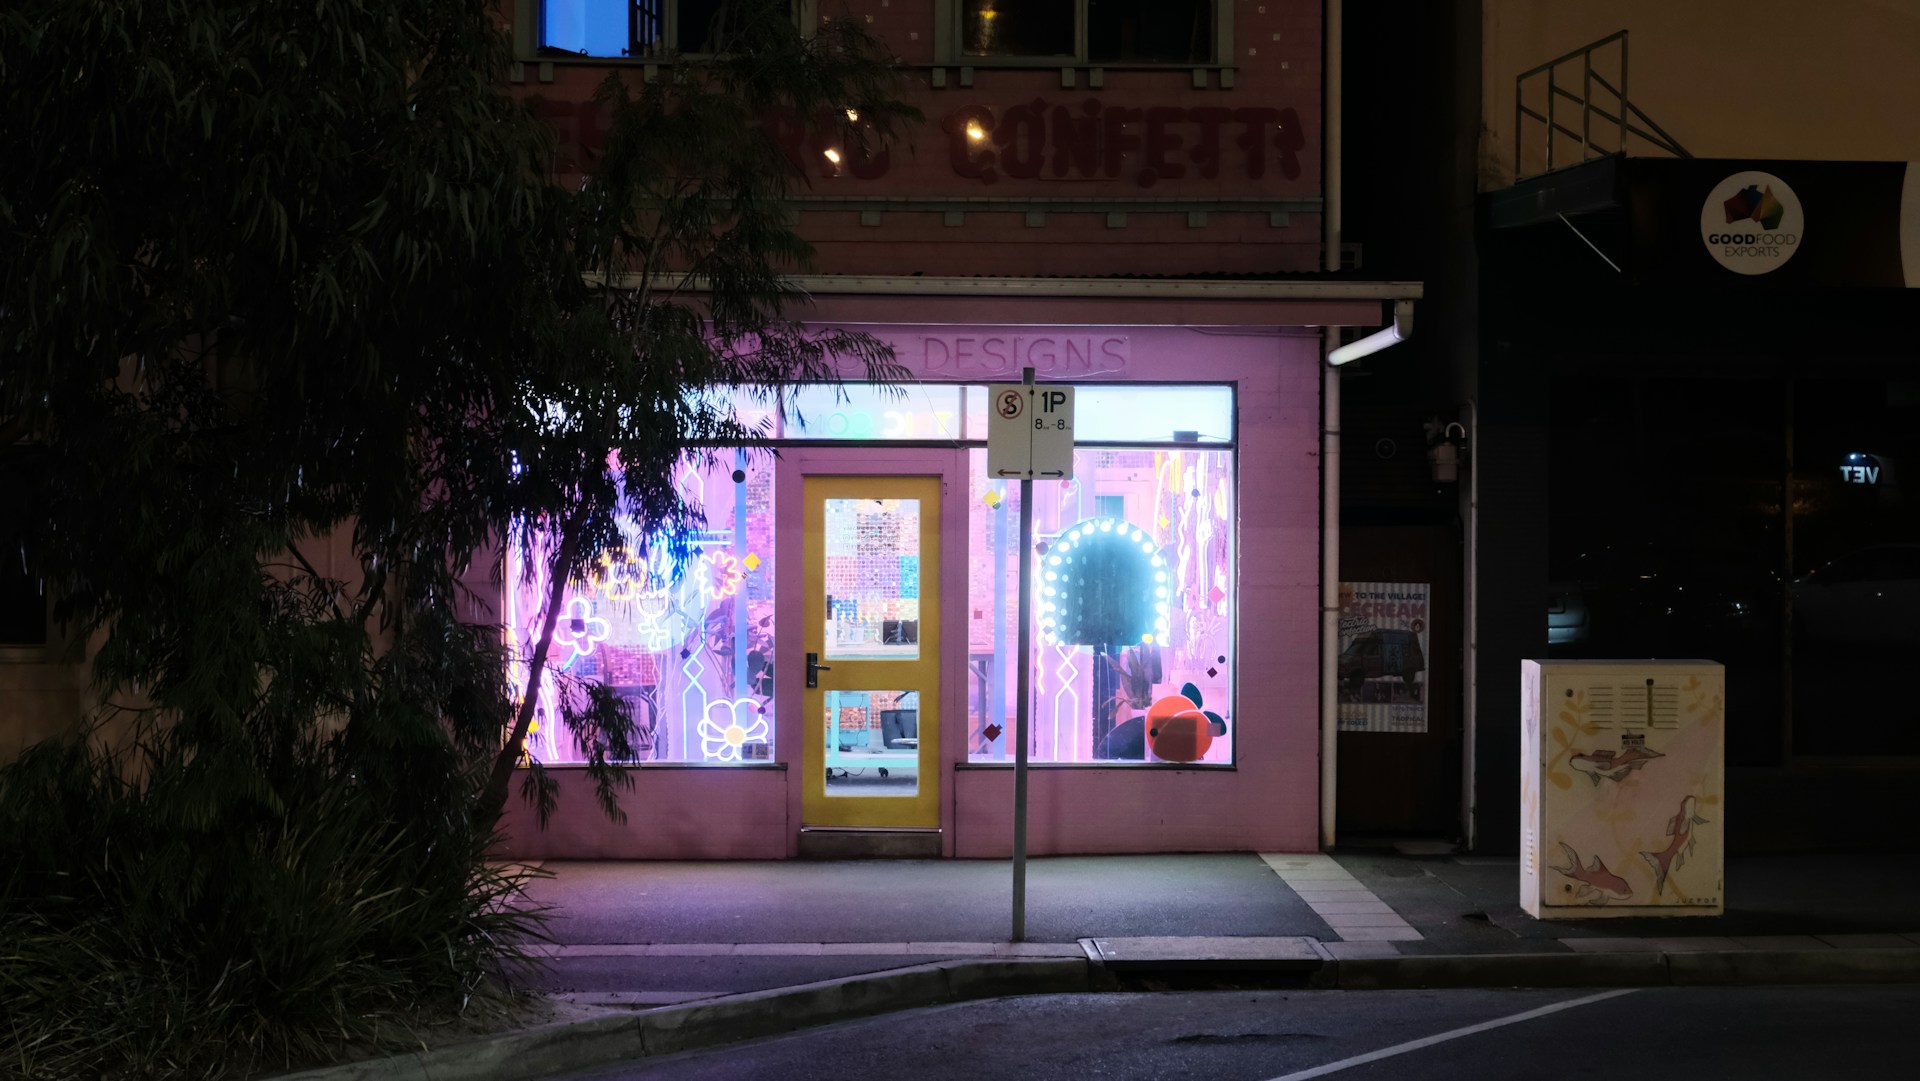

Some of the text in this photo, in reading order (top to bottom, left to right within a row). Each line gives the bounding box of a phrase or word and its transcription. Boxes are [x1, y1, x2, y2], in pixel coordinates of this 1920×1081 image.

[941, 97, 1304, 188] CONFETTI
[1724, 246, 1780, 257] EXPORTS
[924, 337, 1125, 372] DESIGNS
[1042, 392, 1066, 413] 1P
[1388, 593, 1426, 601] VILLAGE!
[1339, 602, 1426, 619] CECREAM
